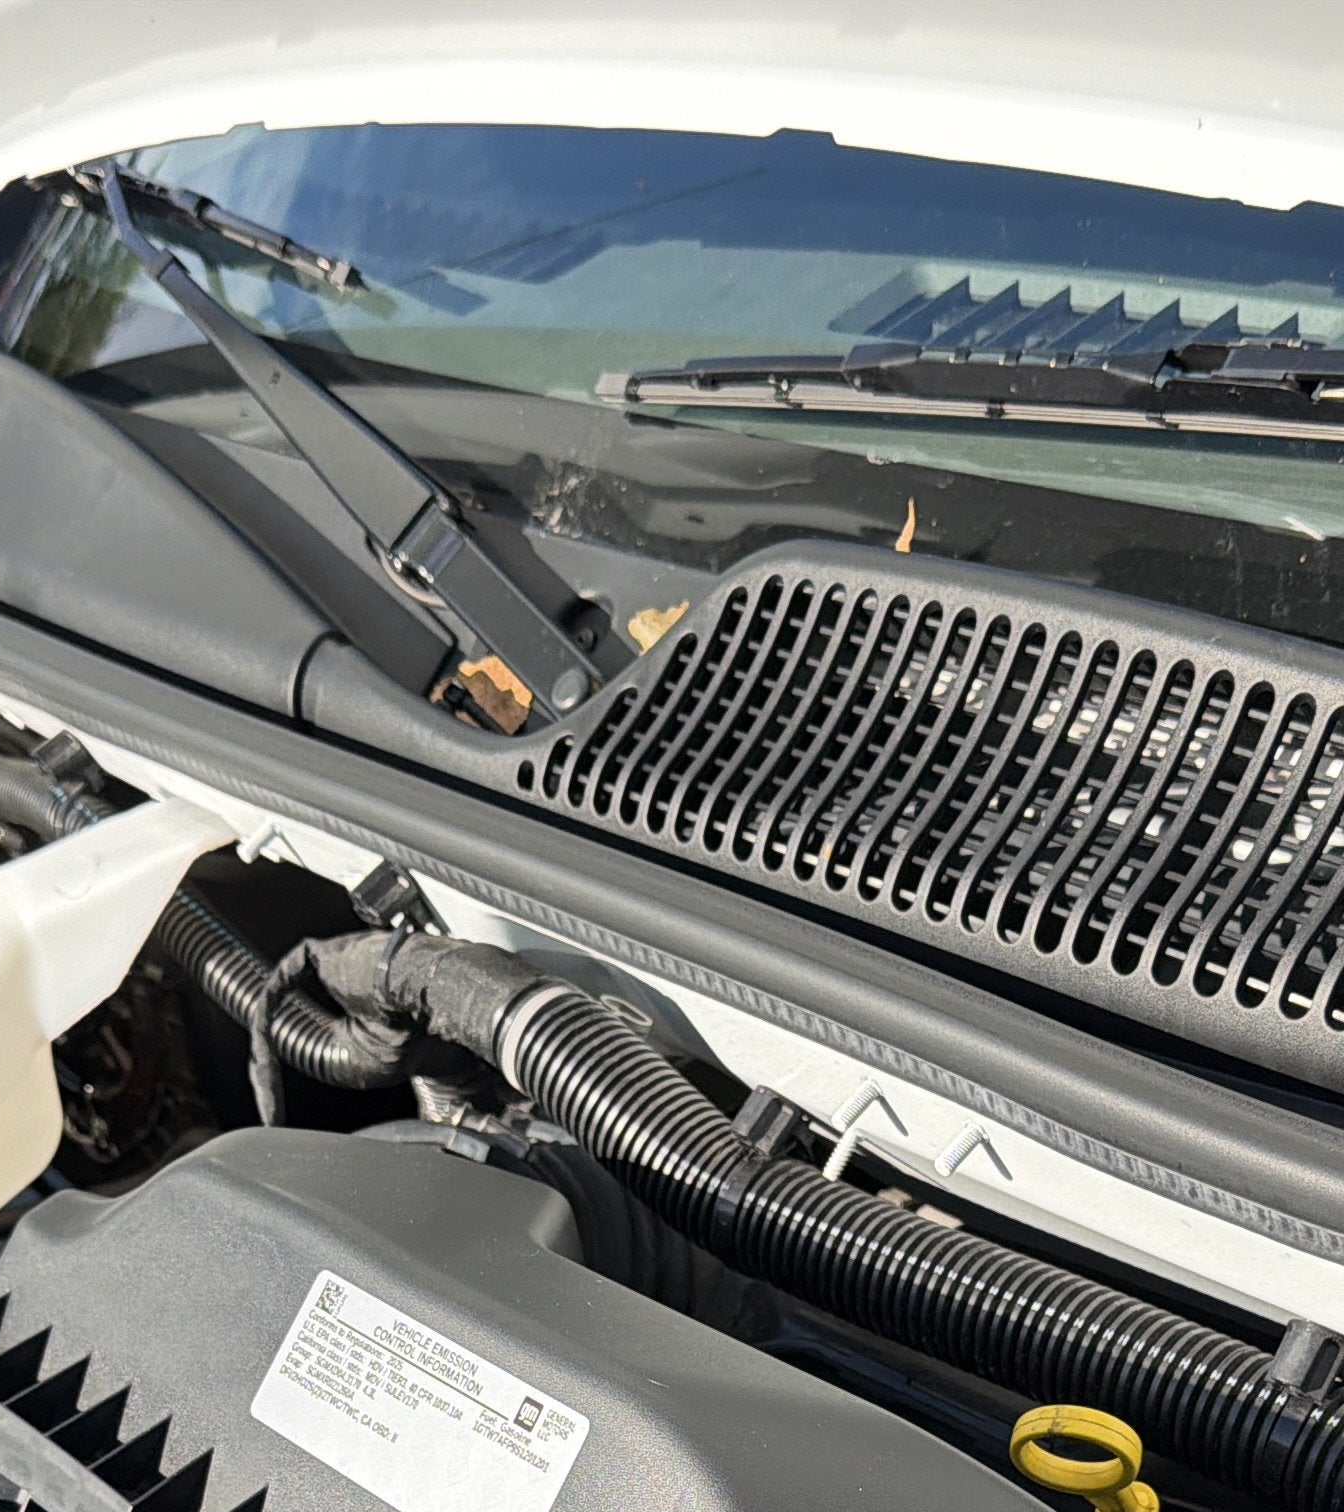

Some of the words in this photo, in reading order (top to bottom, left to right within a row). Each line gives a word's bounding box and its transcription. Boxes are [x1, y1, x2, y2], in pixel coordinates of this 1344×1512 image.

[315, 1327, 329, 1341] EPA
[329, 1337, 346, 1352] class
[417, 1387, 433, 1403] CFR
[373, 1325, 415, 1359] CONTROL
[416, 1351, 483, 1396] INFORMATION
[392, 1319, 432, 1350] VEHICLE
[430, 1341, 478, 1376] EMISSION
